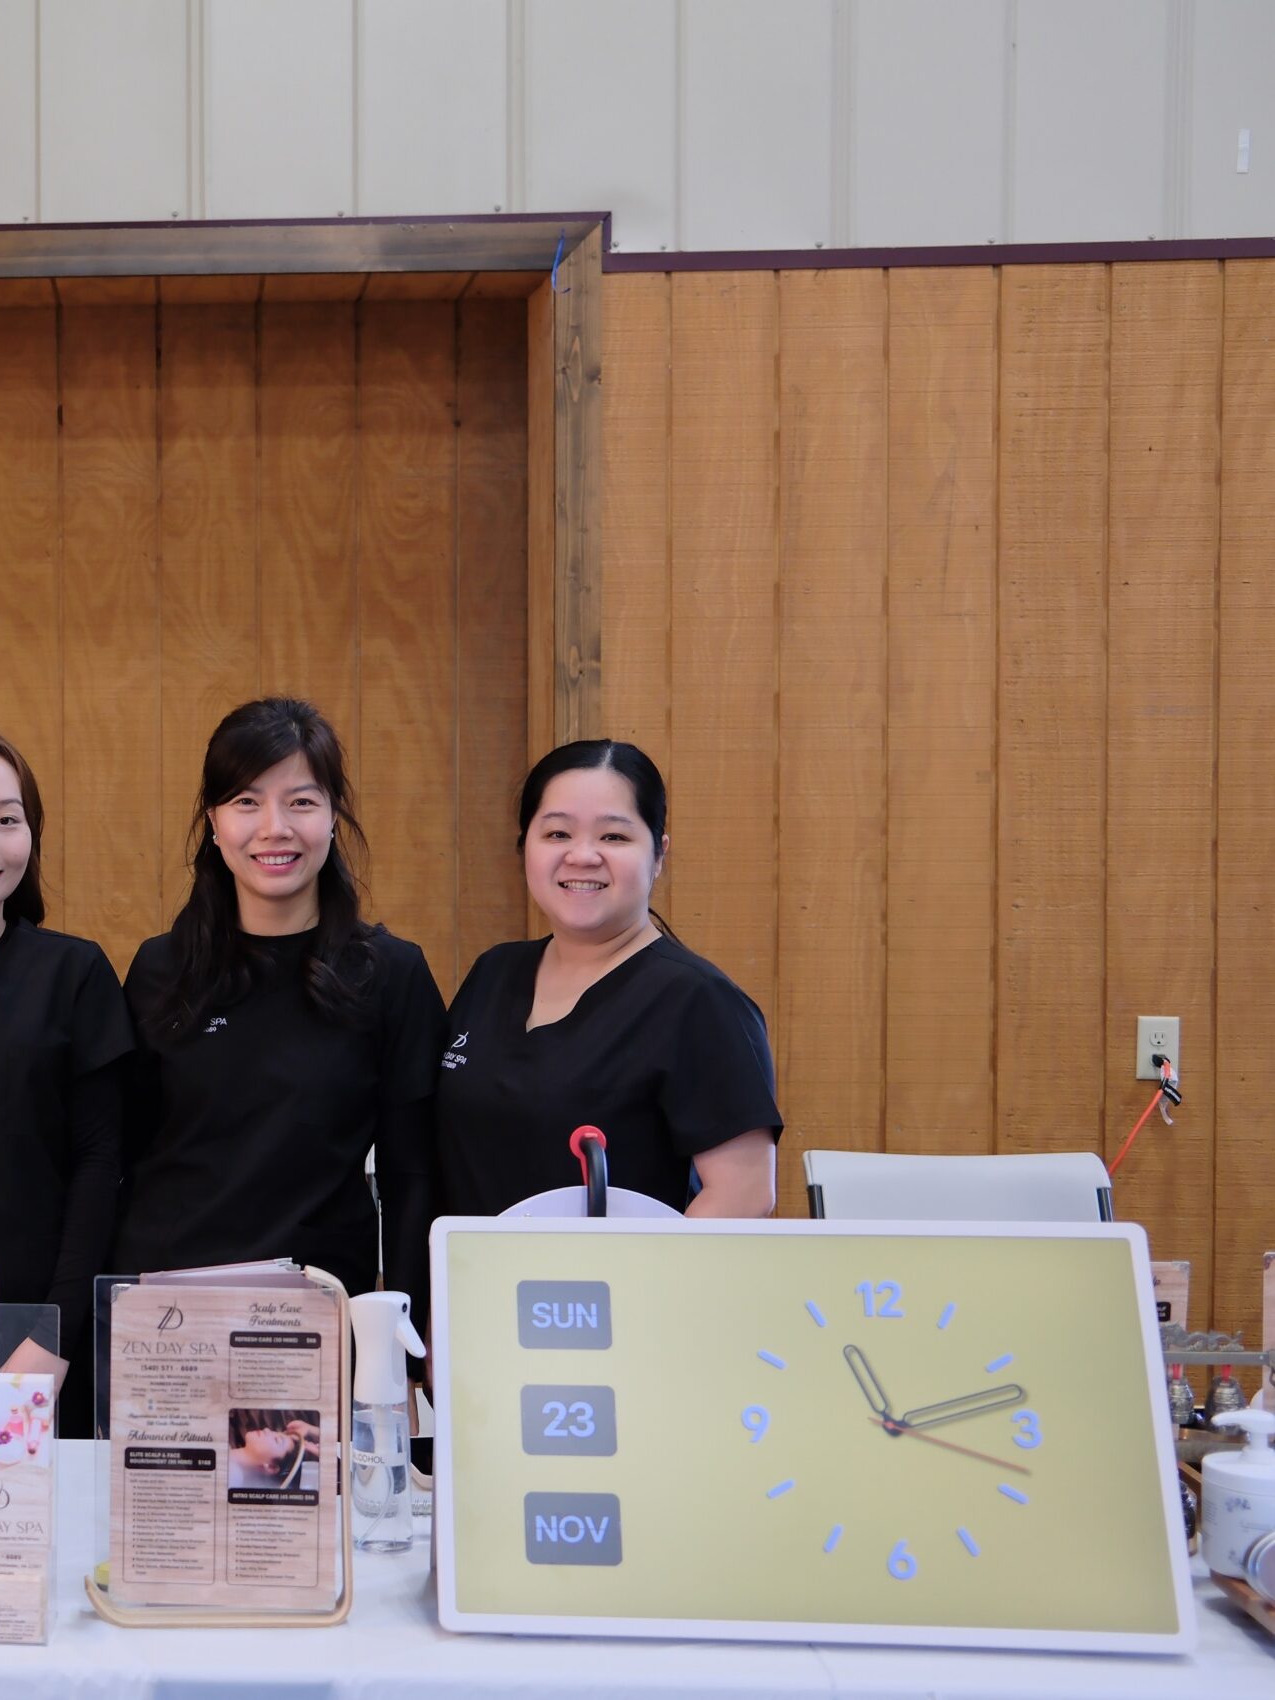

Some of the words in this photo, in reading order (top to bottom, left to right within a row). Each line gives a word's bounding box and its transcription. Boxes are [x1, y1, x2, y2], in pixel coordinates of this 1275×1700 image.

[210, 1017, 227, 1026] SPA
[249, 1301, 277, 1315] Scalp
[279, 1302, 302, 1314] Care
[854, 1279, 906, 1318] 12
[249, 1314, 302, 1327] Treatments
[532, 1302, 598, 1329] SUN
[122, 1340, 151, 1355] ZEN
[156, 1341, 185, 1356] DAY
[189, 1342, 218, 1356] SPA
[542, 1401, 596, 1438] 23
[741, 1404, 772, 1444] 9
[1011, 1409, 1043, 1450] 3
[128, 1429, 178, 1442] Advanced
[180, 1430, 214, 1443] Rituals
[15, 1521, 44, 1535] SPA
[535, 1514, 609, 1544] NOV
[886, 1538, 918, 1582] 6
